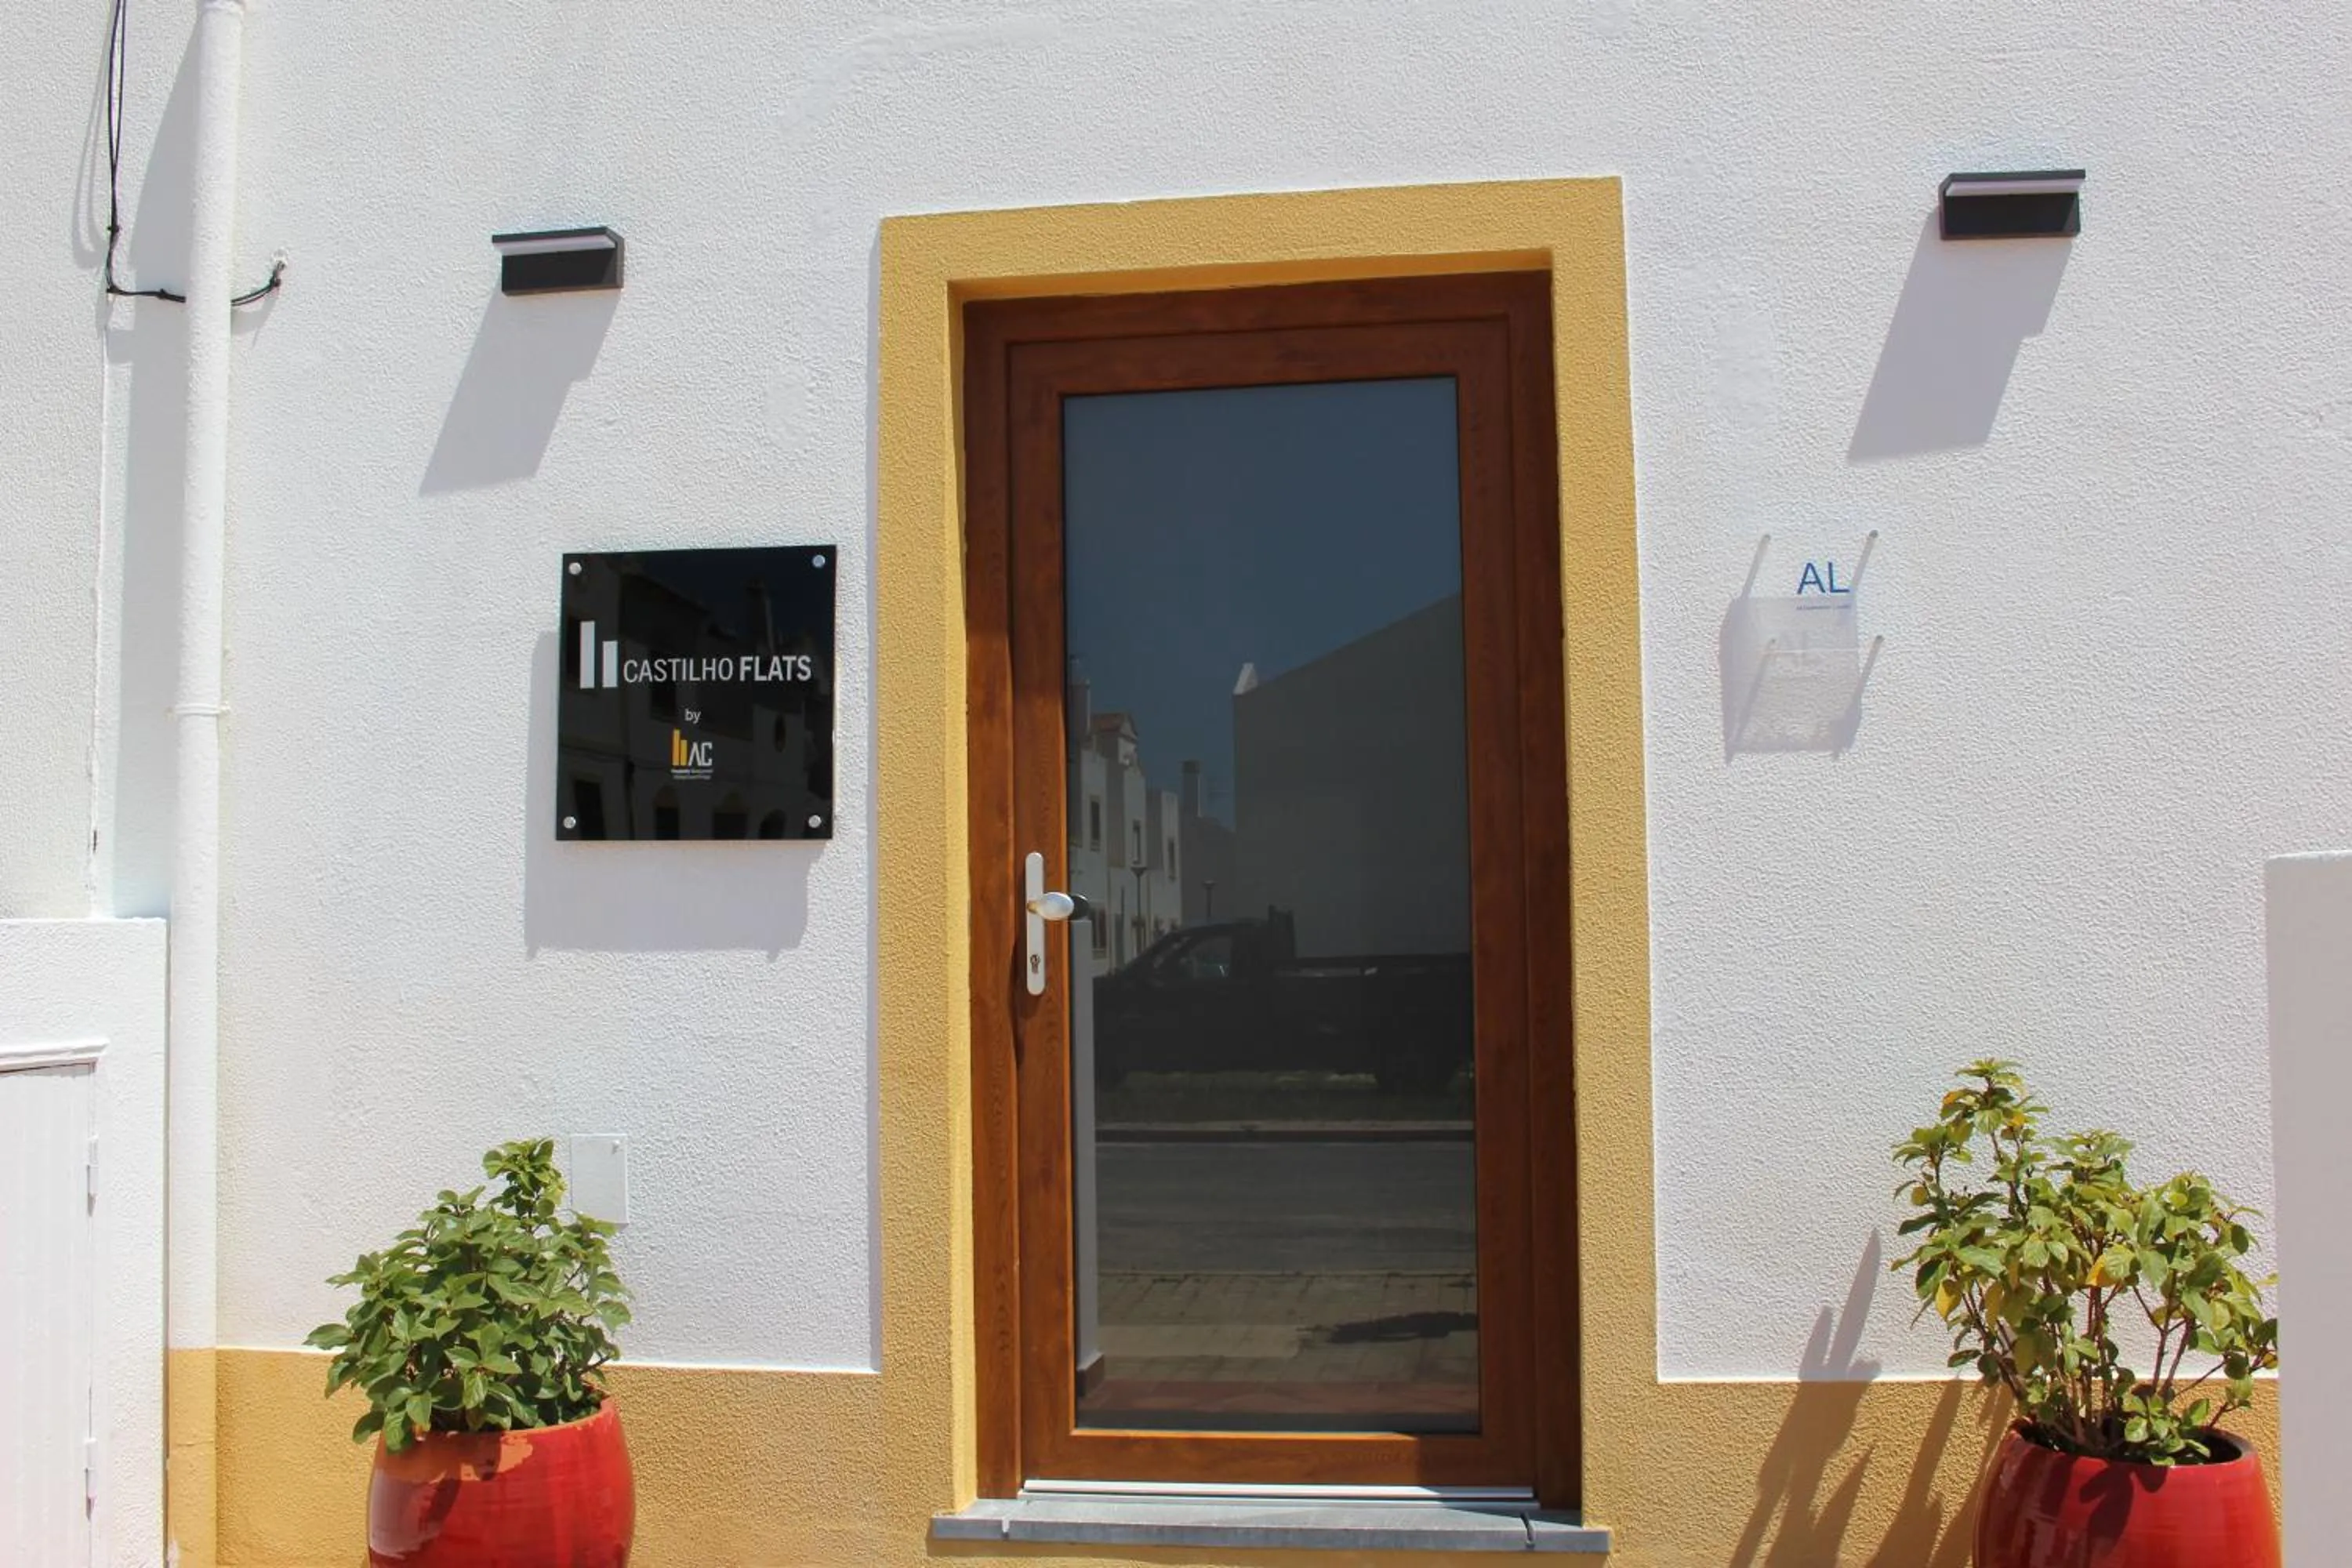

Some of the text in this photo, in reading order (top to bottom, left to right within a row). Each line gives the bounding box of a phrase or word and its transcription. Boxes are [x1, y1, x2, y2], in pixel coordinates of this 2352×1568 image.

[1797, 561, 1849, 594] AL
[623, 655, 811, 682] CASTILHO FLATS
[684, 708, 702, 724] by
